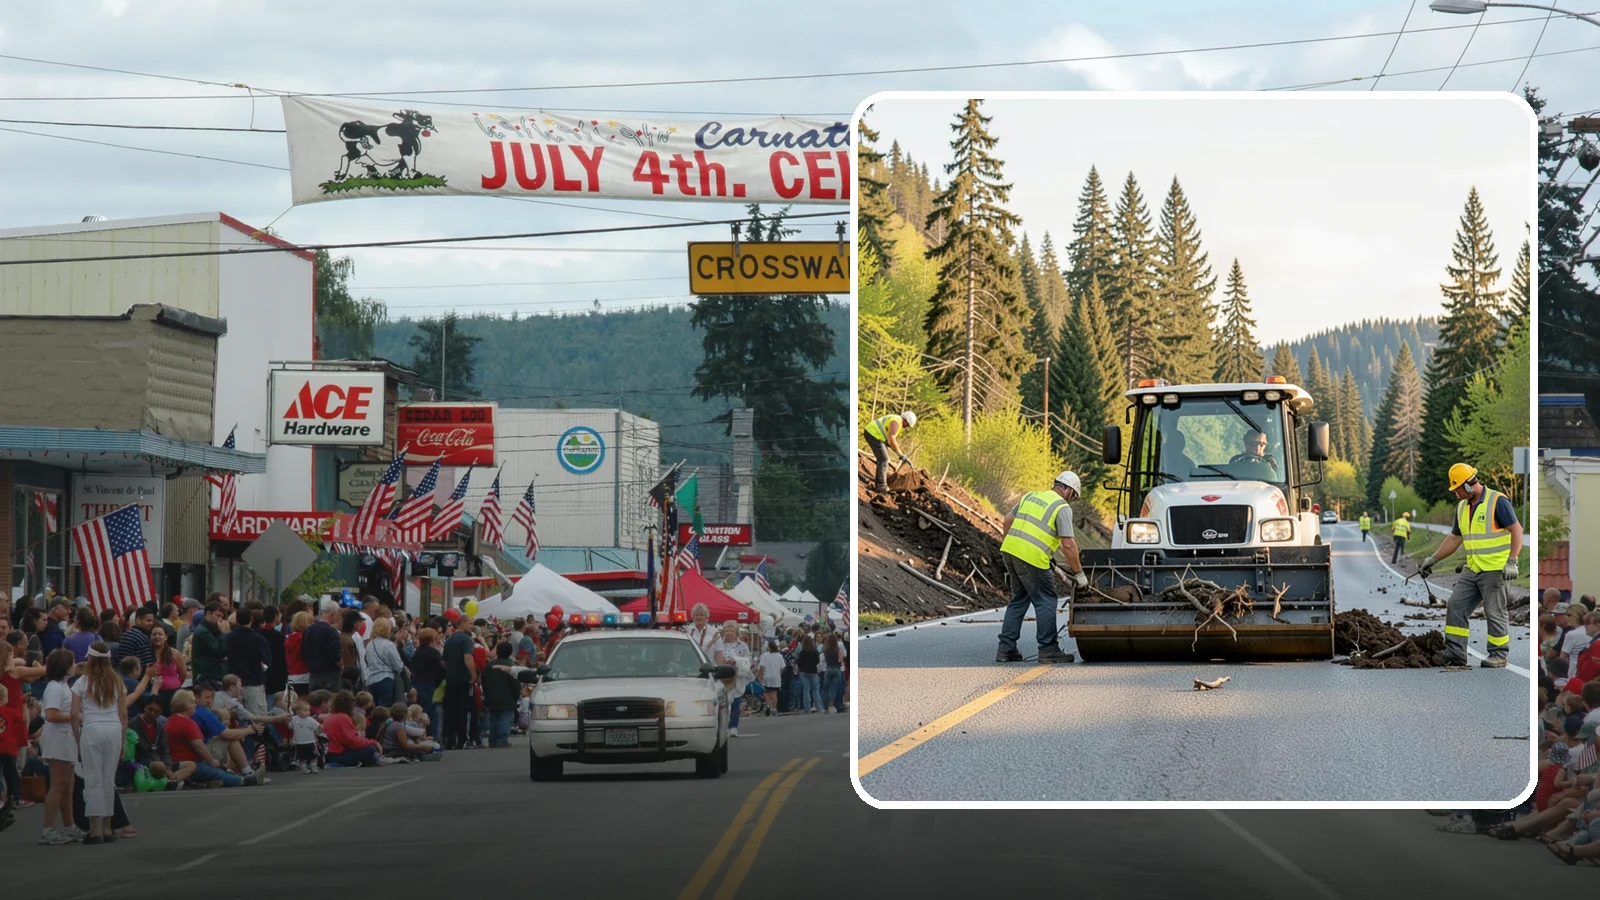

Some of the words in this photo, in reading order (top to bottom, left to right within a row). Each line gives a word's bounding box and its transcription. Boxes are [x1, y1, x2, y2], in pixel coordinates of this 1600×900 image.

[481, 140, 604, 193] JULY
[632, 150, 746, 197] 4th.
[697, 254, 850, 280] CROSSWA
[282, 380, 373, 420] ACE
[406, 409, 452, 422] CEDAR
[283, 421, 371, 436] Hardware
[416, 428, 477, 447] Coca-Cola
[83, 485, 94, 494] St.
[96, 485, 124, 495] Vincent
[126, 486, 136, 495] de
[138, 486, 155, 495] Paul
[688, 527, 741, 535] CRNATION
